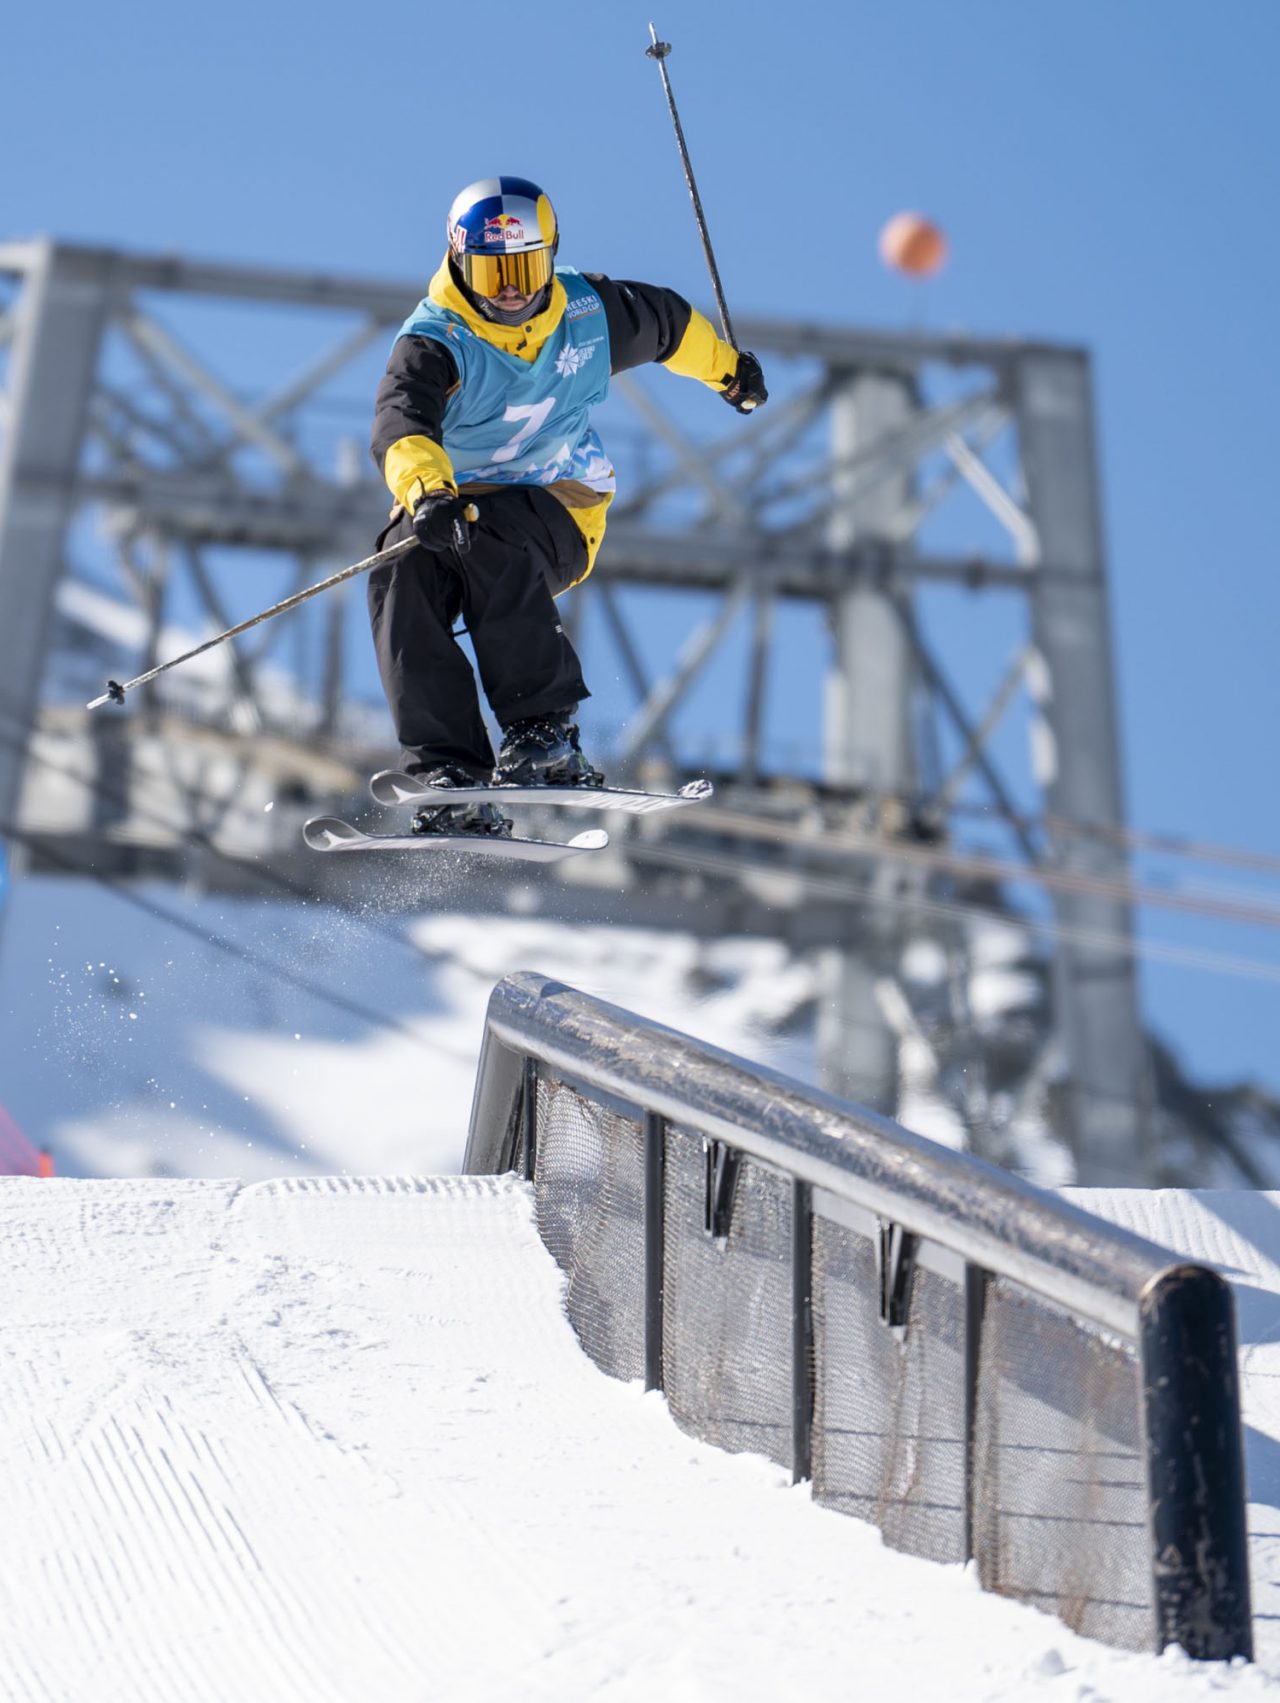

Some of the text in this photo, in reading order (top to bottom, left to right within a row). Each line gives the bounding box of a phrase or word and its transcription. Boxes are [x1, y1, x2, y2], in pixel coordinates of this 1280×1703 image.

[485, 229, 525, 242] Red Bull
[566, 295, 597, 312] REESKI
[491, 397, 556, 463] 7
